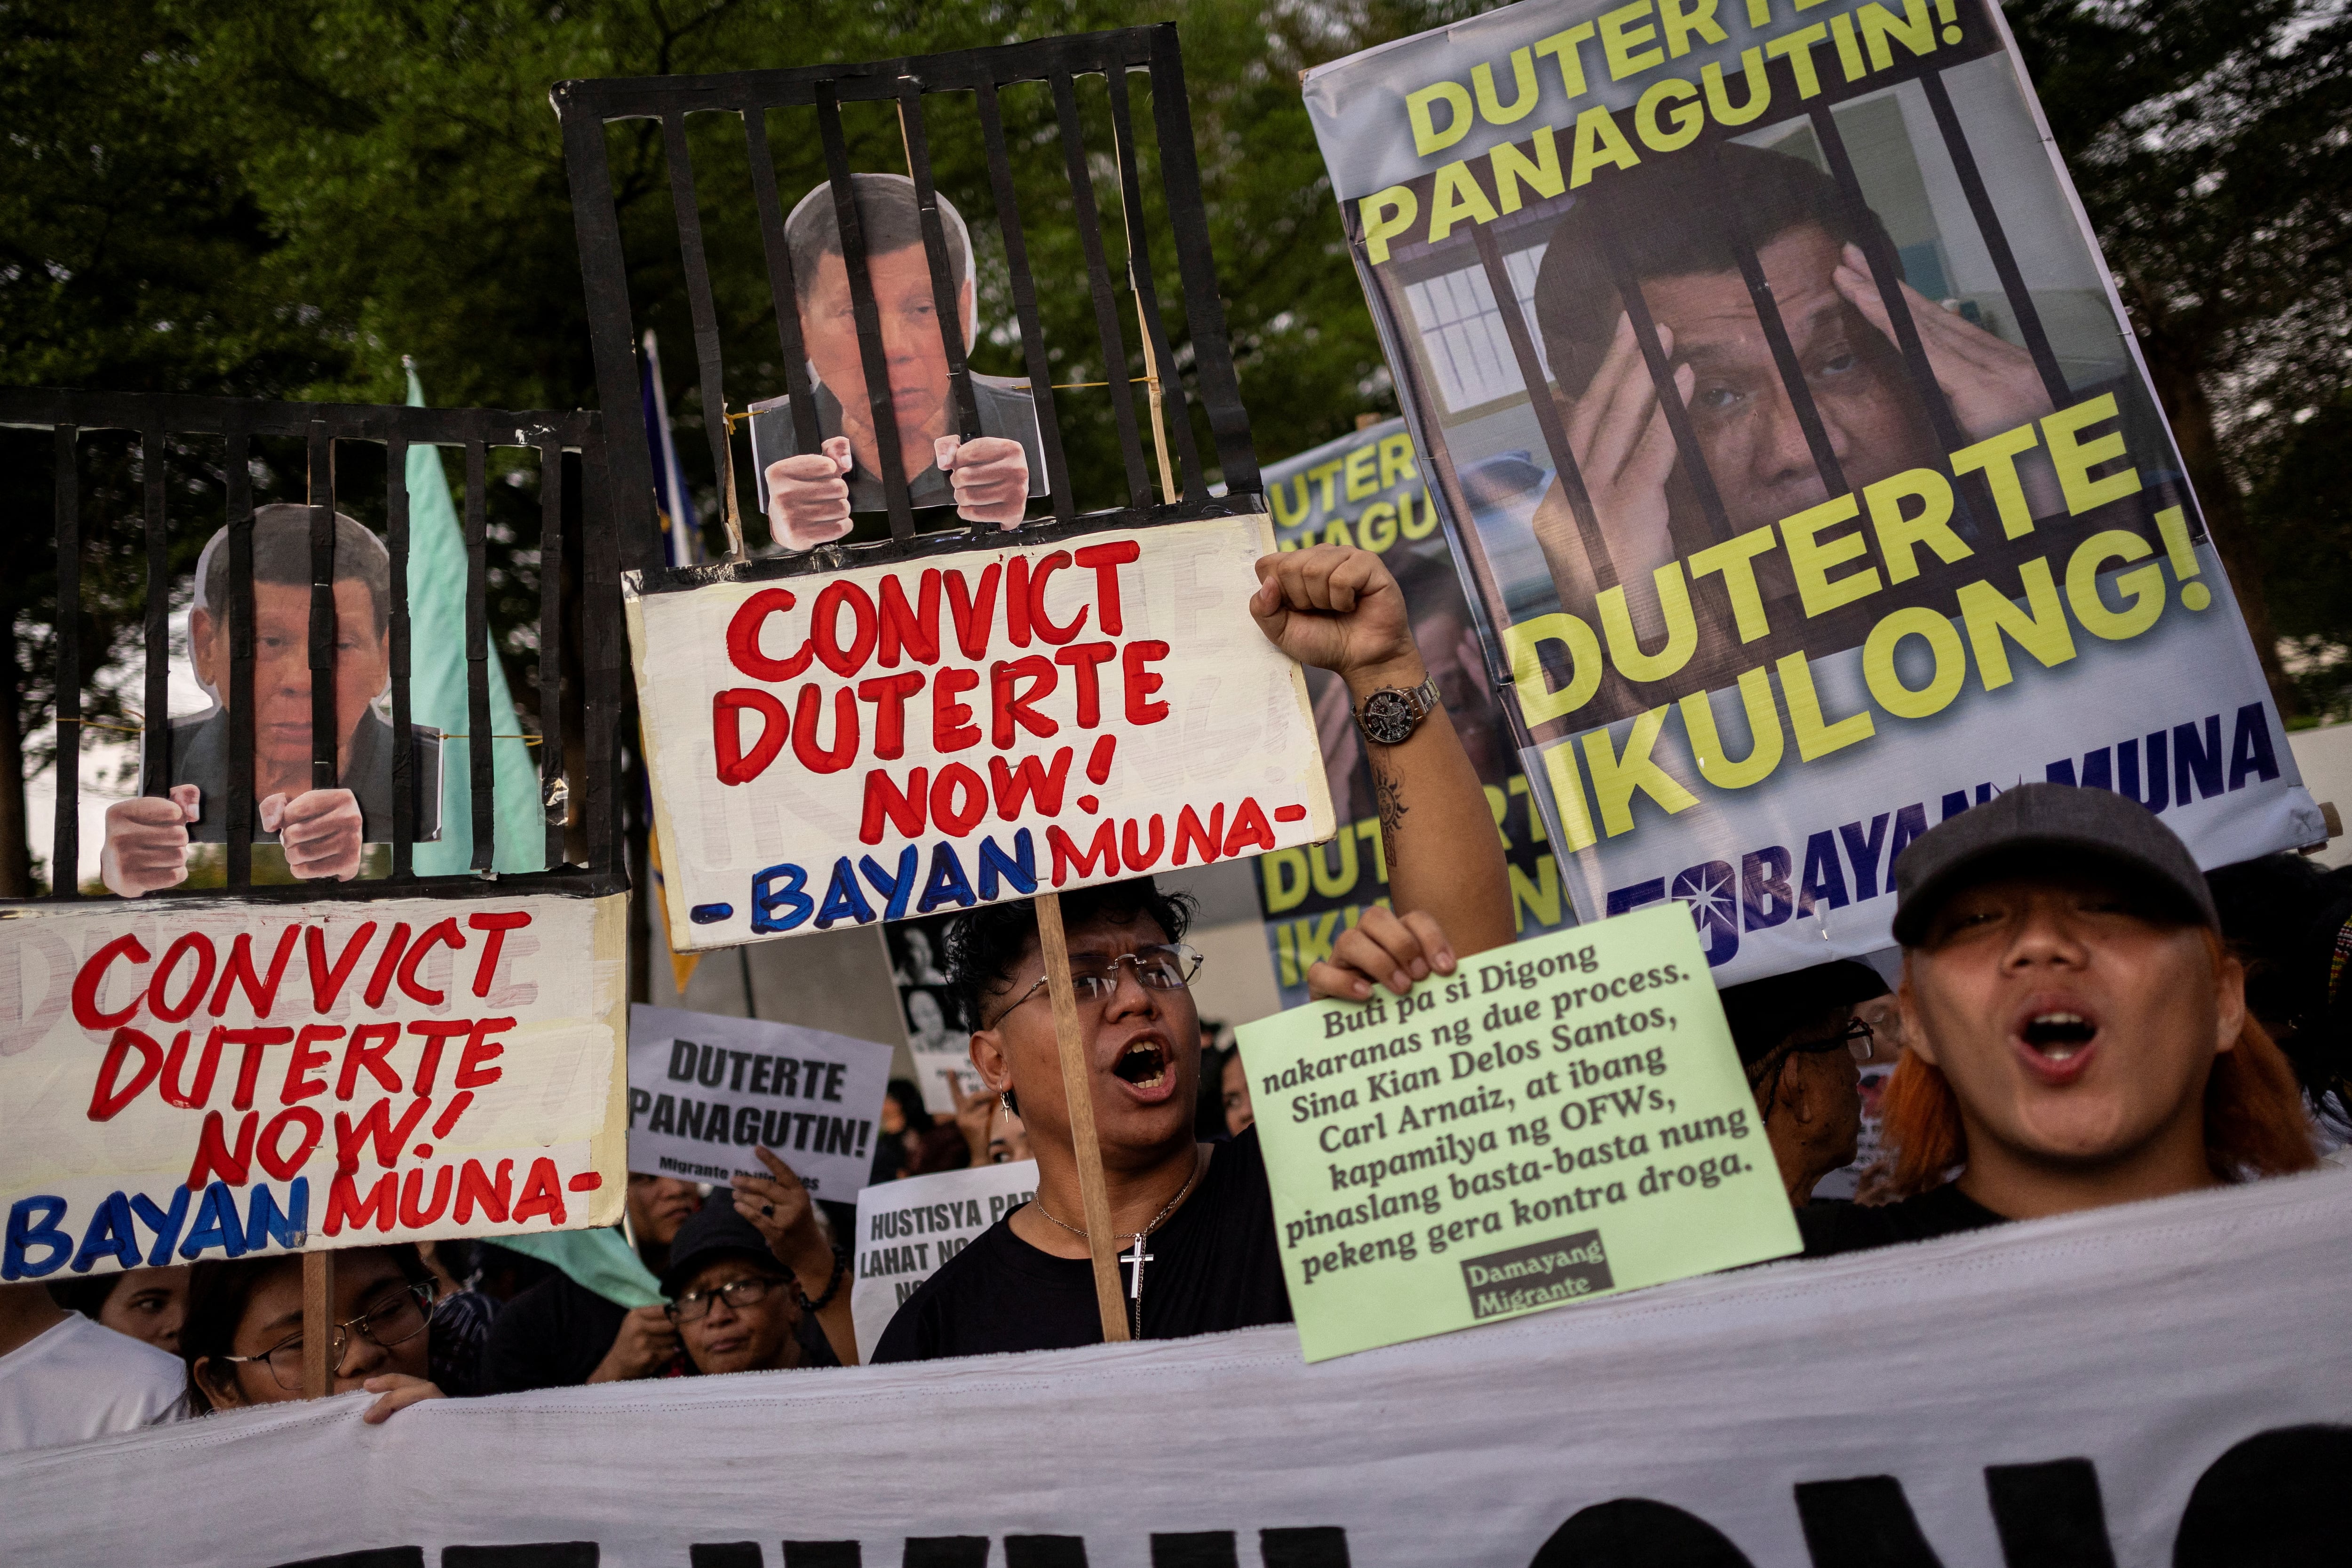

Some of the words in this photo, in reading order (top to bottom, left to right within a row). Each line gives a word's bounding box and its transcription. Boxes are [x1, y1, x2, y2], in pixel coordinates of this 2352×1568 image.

[1405, 0, 1829, 158] DUTER
[1358, 0, 1963, 266] PANAGUTIN!
[1270, 432, 1418, 528] UTER
[726, 540, 1141, 683] CONVICT
[1502, 392, 2142, 729] DUTERTE
[713, 640, 1170, 786] DUTERTE
[1543, 505, 2211, 852] IKULONG!
[859, 734, 1116, 845] NOW!
[72, 911, 532, 1030] CONVICT
[1323, 998, 1388, 1038] Buti
[1396, 990, 1435, 1024] pa
[1445, 972, 1471, 1003] si
[1480, 945, 1599, 995] Digong
[87, 1016, 517, 1122] DUTERTE
[667, 1039, 847, 1103] DUTERTE
[1263, 1032, 1422, 1095] nakaranas
[1432, 1017, 1473, 1046] ng
[1483, 999, 1541, 1032] due
[1551, 963, 1690, 1019] process.
[1292, 1089, 1359, 1122] Sina
[1367, 1066, 1441, 1102] Kian
[1449, 1039, 1541, 1080] Delos
[1551, 1006, 1677, 1053] Santos,
[188, 1091, 474, 1191] NOW!
[629, 1086, 872, 1158] PANAGUTIN!
[1319, 1113, 1388, 1153] Carl
[1398, 1085, 1515, 1134] Arnaiz,
[1526, 1069, 1562, 1100] at
[1569, 1046, 1667, 1089] ibang
[1328, 1130, 1499, 1191] kapamilya
[1508, 1116, 1551, 1146] ng
[1560, 1085, 1676, 1131] OFWs,
[660, 1156, 729, 1180] Migrante
[871, 1199, 984, 1242] HUSTISYA
[1286, 1185, 1441, 1249] pinaslang
[1449, 1134, 1650, 1201] basta-basta
[1659, 1108, 1750, 1149] nung
[1302, 1231, 1417, 1285] pekeng
[1428, 1211, 1503, 1254] gera
[1510, 1180, 1627, 1226] kontra
[1638, 1153, 1752, 1196] droga.
[1, 1177, 309, 1281] BAYAN
[860, 1242, 929, 1279] LAHAT
[1466, 1239, 1604, 1288] Damayang
[1476, 1276, 1591, 1317] Migrante
